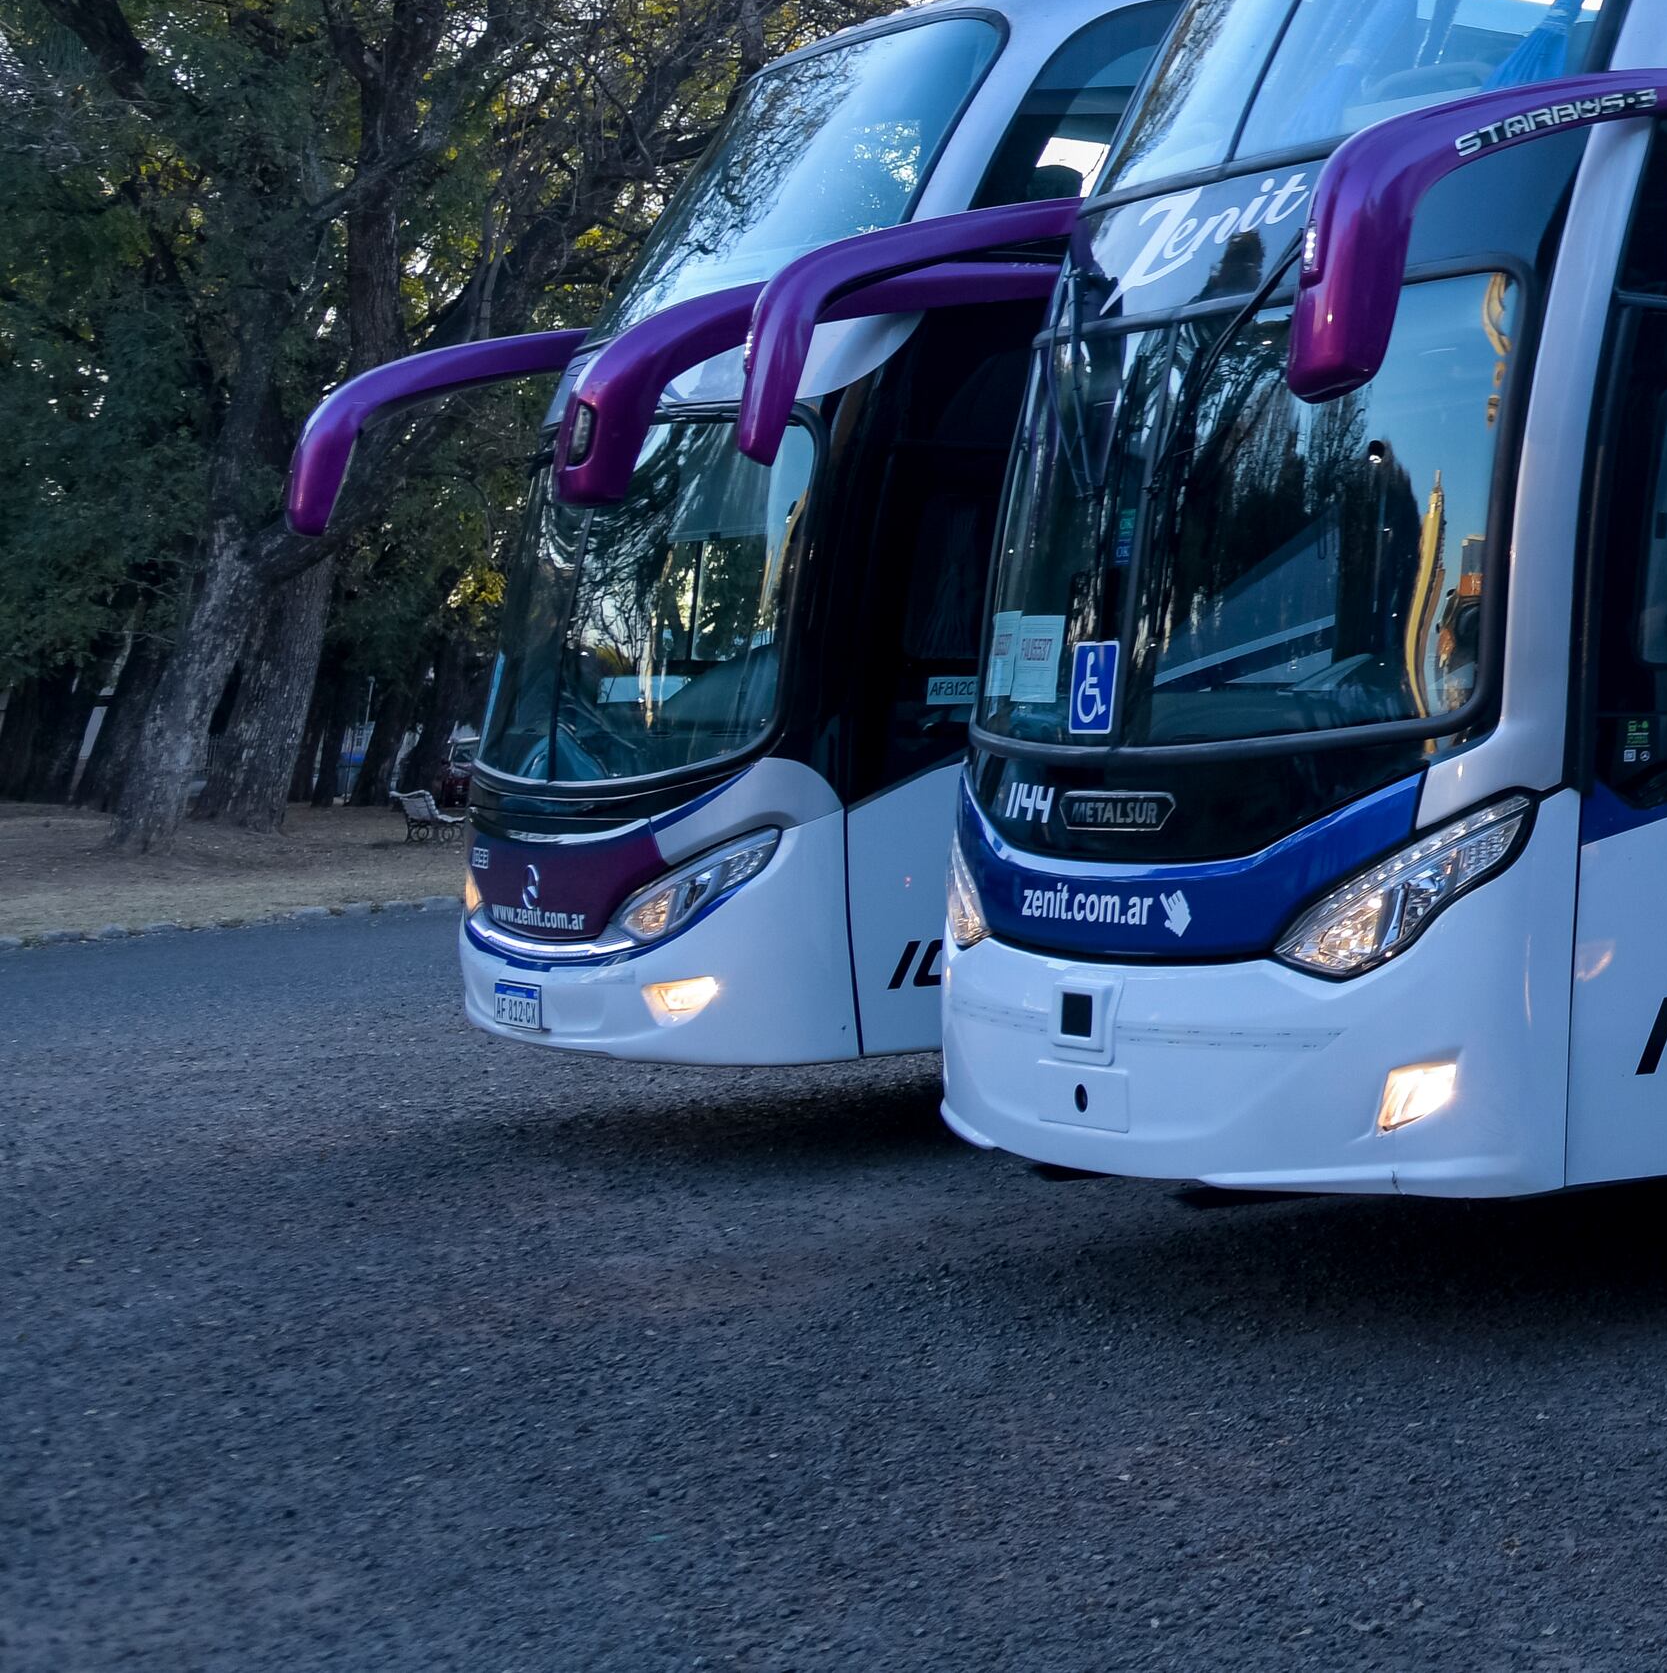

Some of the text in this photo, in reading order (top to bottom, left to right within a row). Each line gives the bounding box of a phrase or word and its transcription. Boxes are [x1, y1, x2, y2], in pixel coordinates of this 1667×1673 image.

[1100, 172, 1310, 317] Zenit
[930, 681, 978, 696] AF812C
[1005, 782, 1055, 824] 1144
[1071, 802, 1158, 824] METALSUR
[491, 903, 586, 931] www.zenit.com.ar
[1021, 882, 1154, 926] zenit.com.ar
[508, 999, 523, 1023] 812
